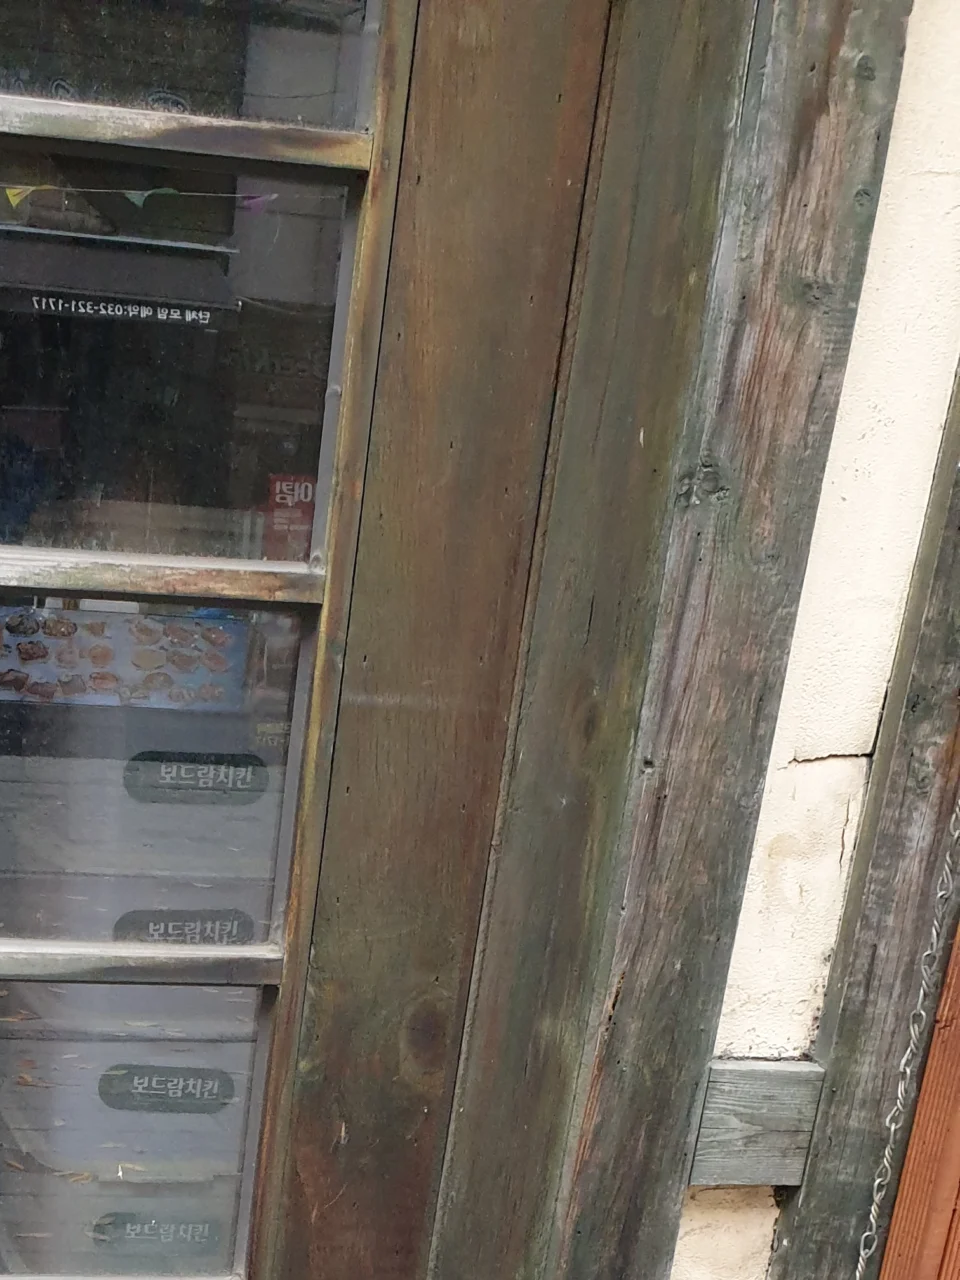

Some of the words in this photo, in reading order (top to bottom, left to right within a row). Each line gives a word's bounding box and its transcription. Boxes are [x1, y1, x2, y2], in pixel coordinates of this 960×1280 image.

[159, 763, 255, 788] 보드람치킨
[131, 1076, 218, 1098] 보드람치킨
[124, 1223, 209, 1242] 보드람치킨
